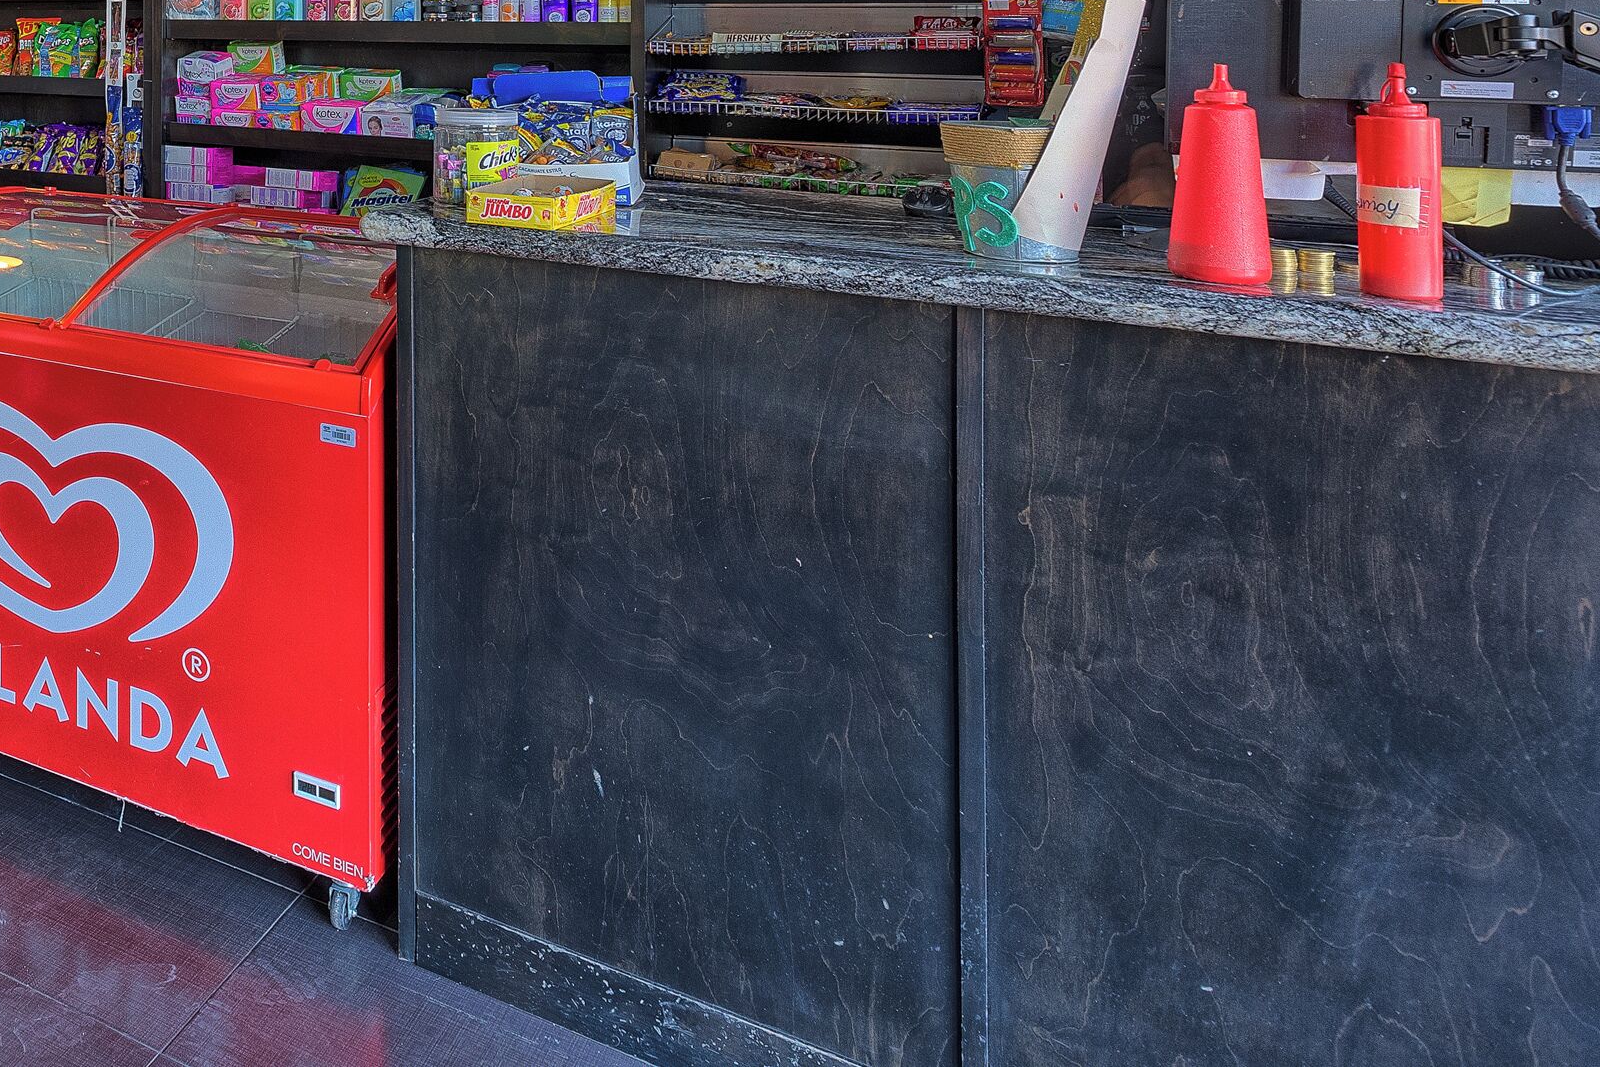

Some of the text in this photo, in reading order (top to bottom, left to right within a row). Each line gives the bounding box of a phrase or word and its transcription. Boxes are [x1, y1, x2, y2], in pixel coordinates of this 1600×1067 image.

[241, 47, 258, 56] kotex
[358, 77, 377, 85] kotex
[224, 85, 243, 94] kotex
[179, 102, 198, 110] kotex
[224, 115, 243, 123] kotex
[316, 109, 341, 120] kotex
[351, 195, 413, 208] Magitel
[480, 202, 533, 221] JUMBO
[292, 842, 364, 879] COME BIEN
